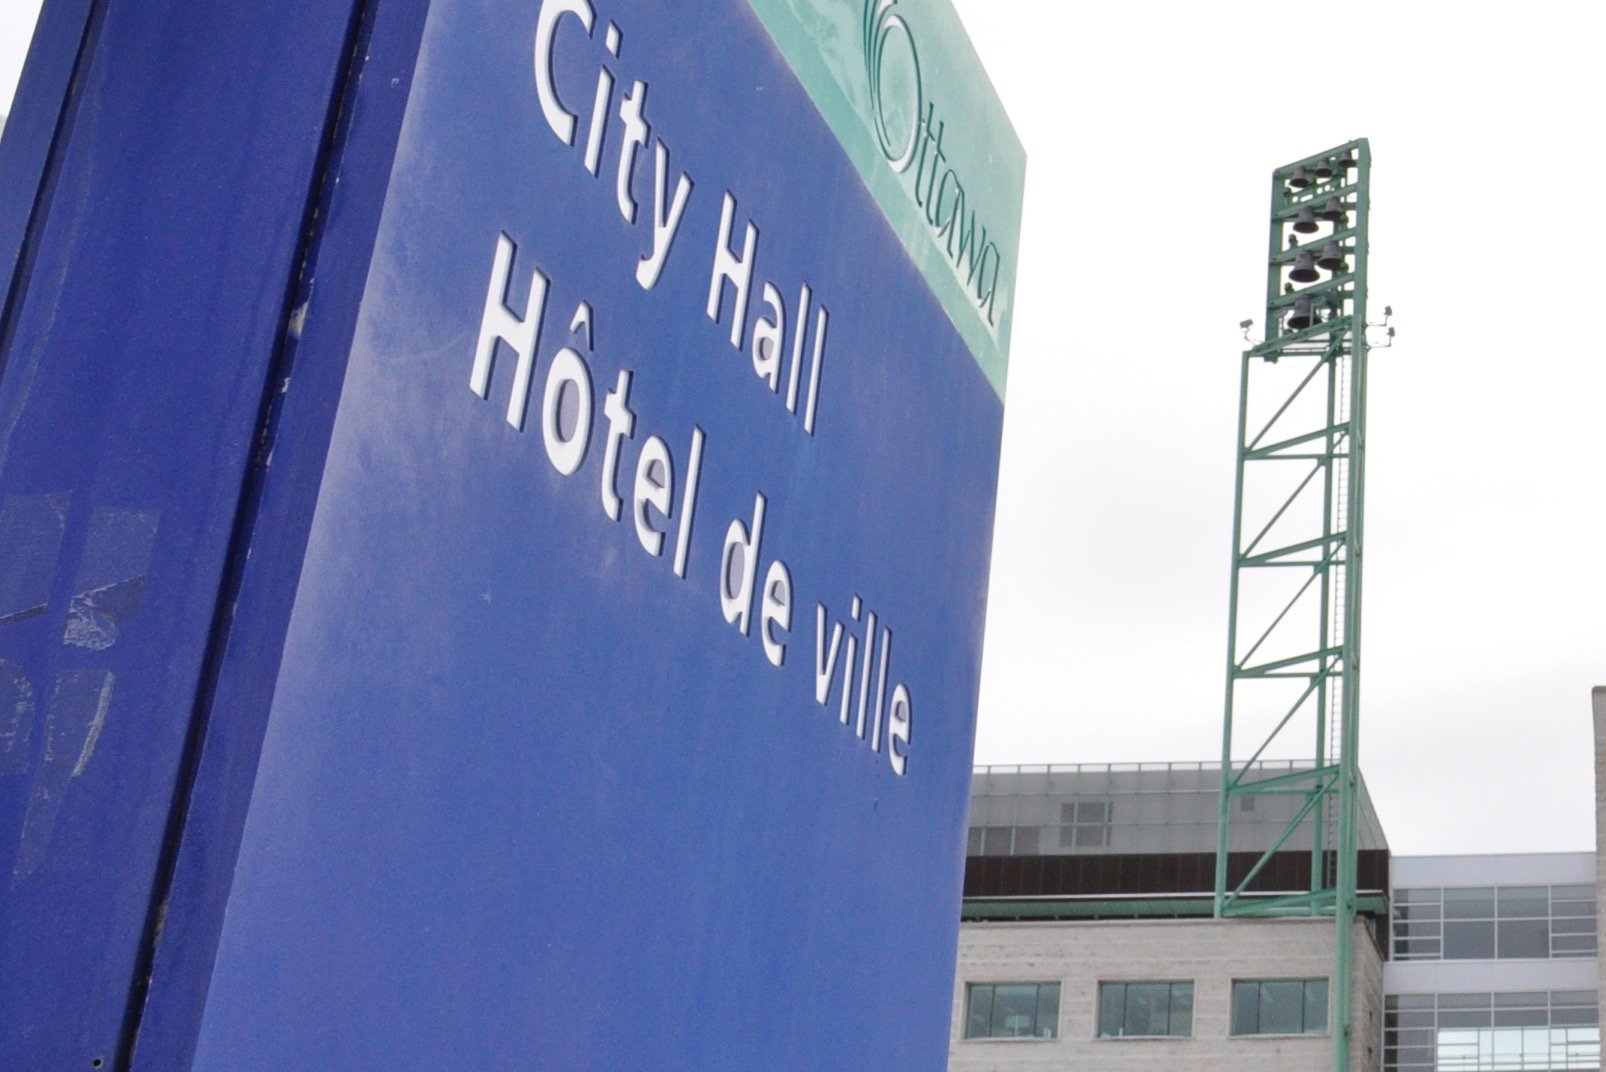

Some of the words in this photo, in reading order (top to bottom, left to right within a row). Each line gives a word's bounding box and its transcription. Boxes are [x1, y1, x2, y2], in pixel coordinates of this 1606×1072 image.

[534, 0, 694, 290] City
[706, 189, 829, 436] Hall
[866, 4, 1001, 327] Ottawa
[469, 230, 706, 580] Hôtel
[720, 490, 795, 667] de
[816, 593, 912, 776] ville
